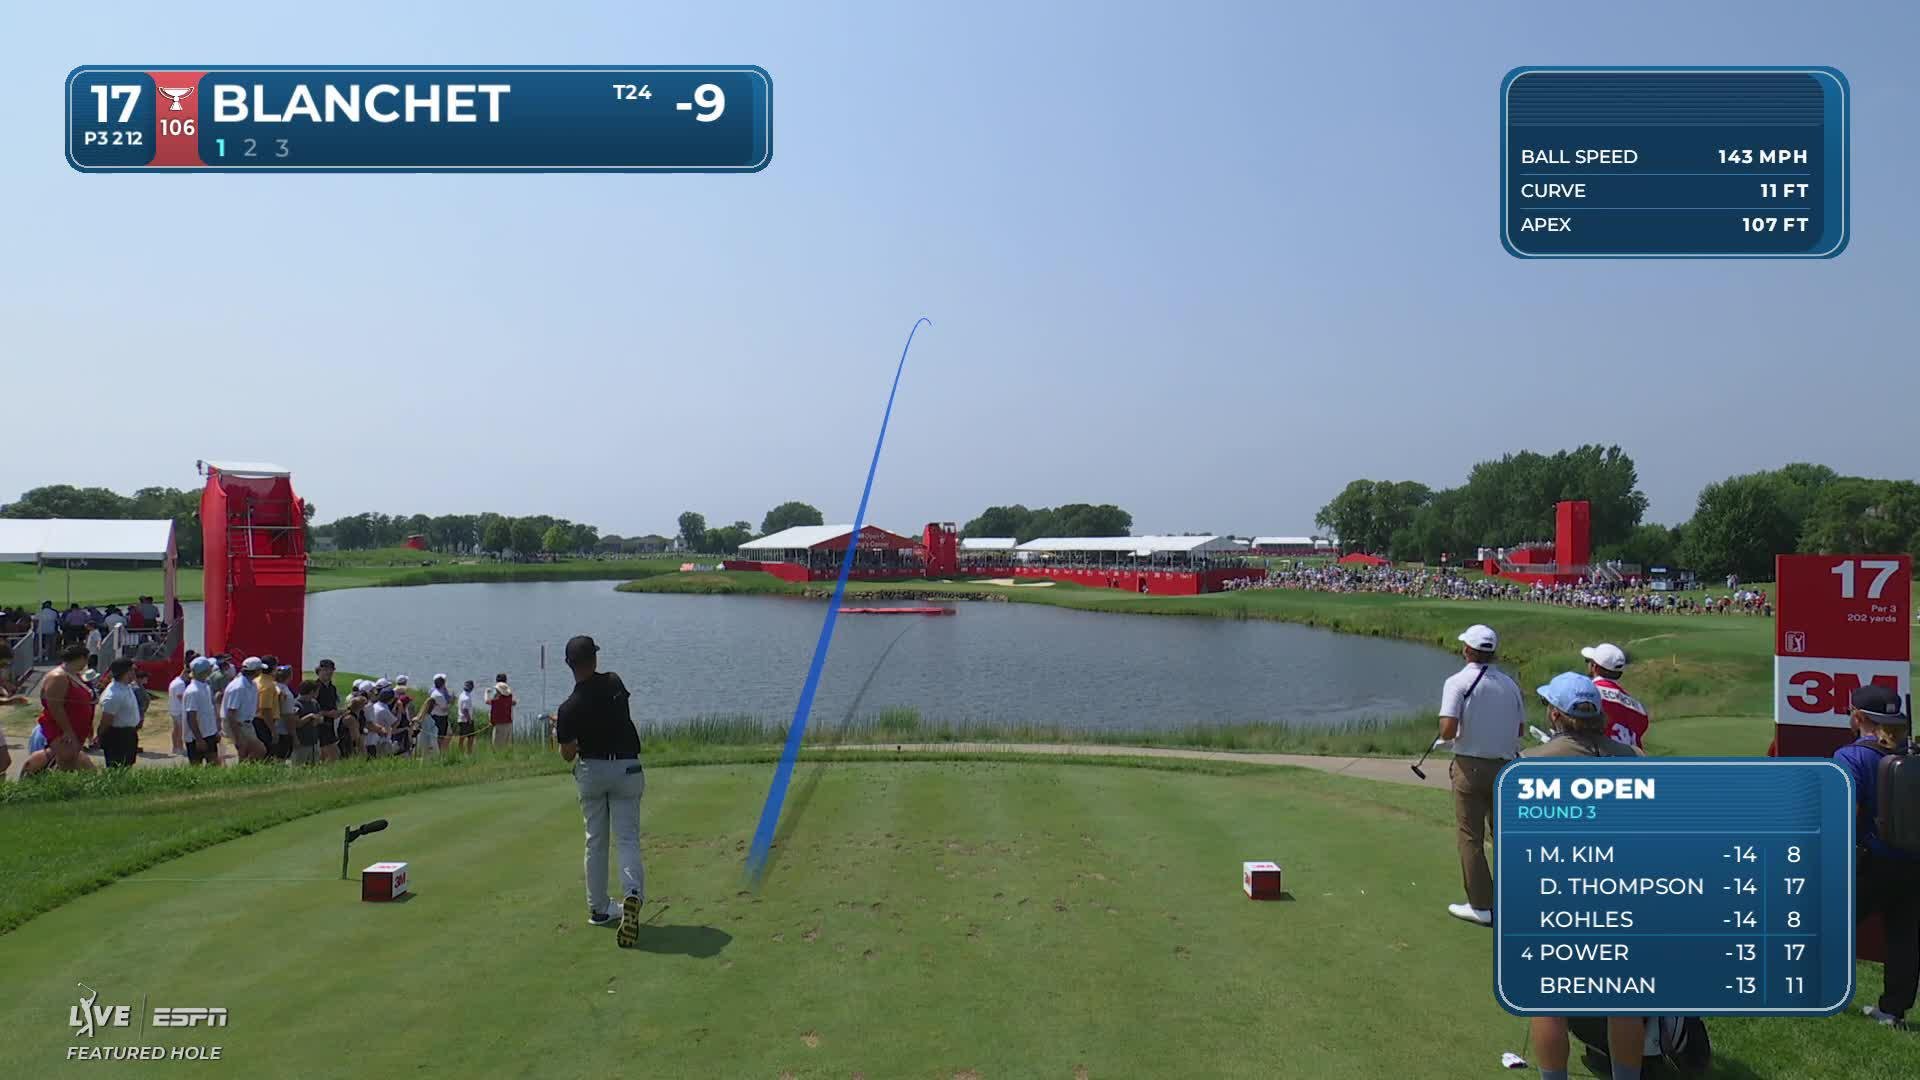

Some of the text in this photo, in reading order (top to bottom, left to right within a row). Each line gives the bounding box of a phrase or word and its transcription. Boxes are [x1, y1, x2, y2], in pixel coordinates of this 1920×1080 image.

[1832, 561, 1899, 598] 17
[1872, 604, 1897, 613] Par 3
[1848, 614, 1897, 624] 202 yards
